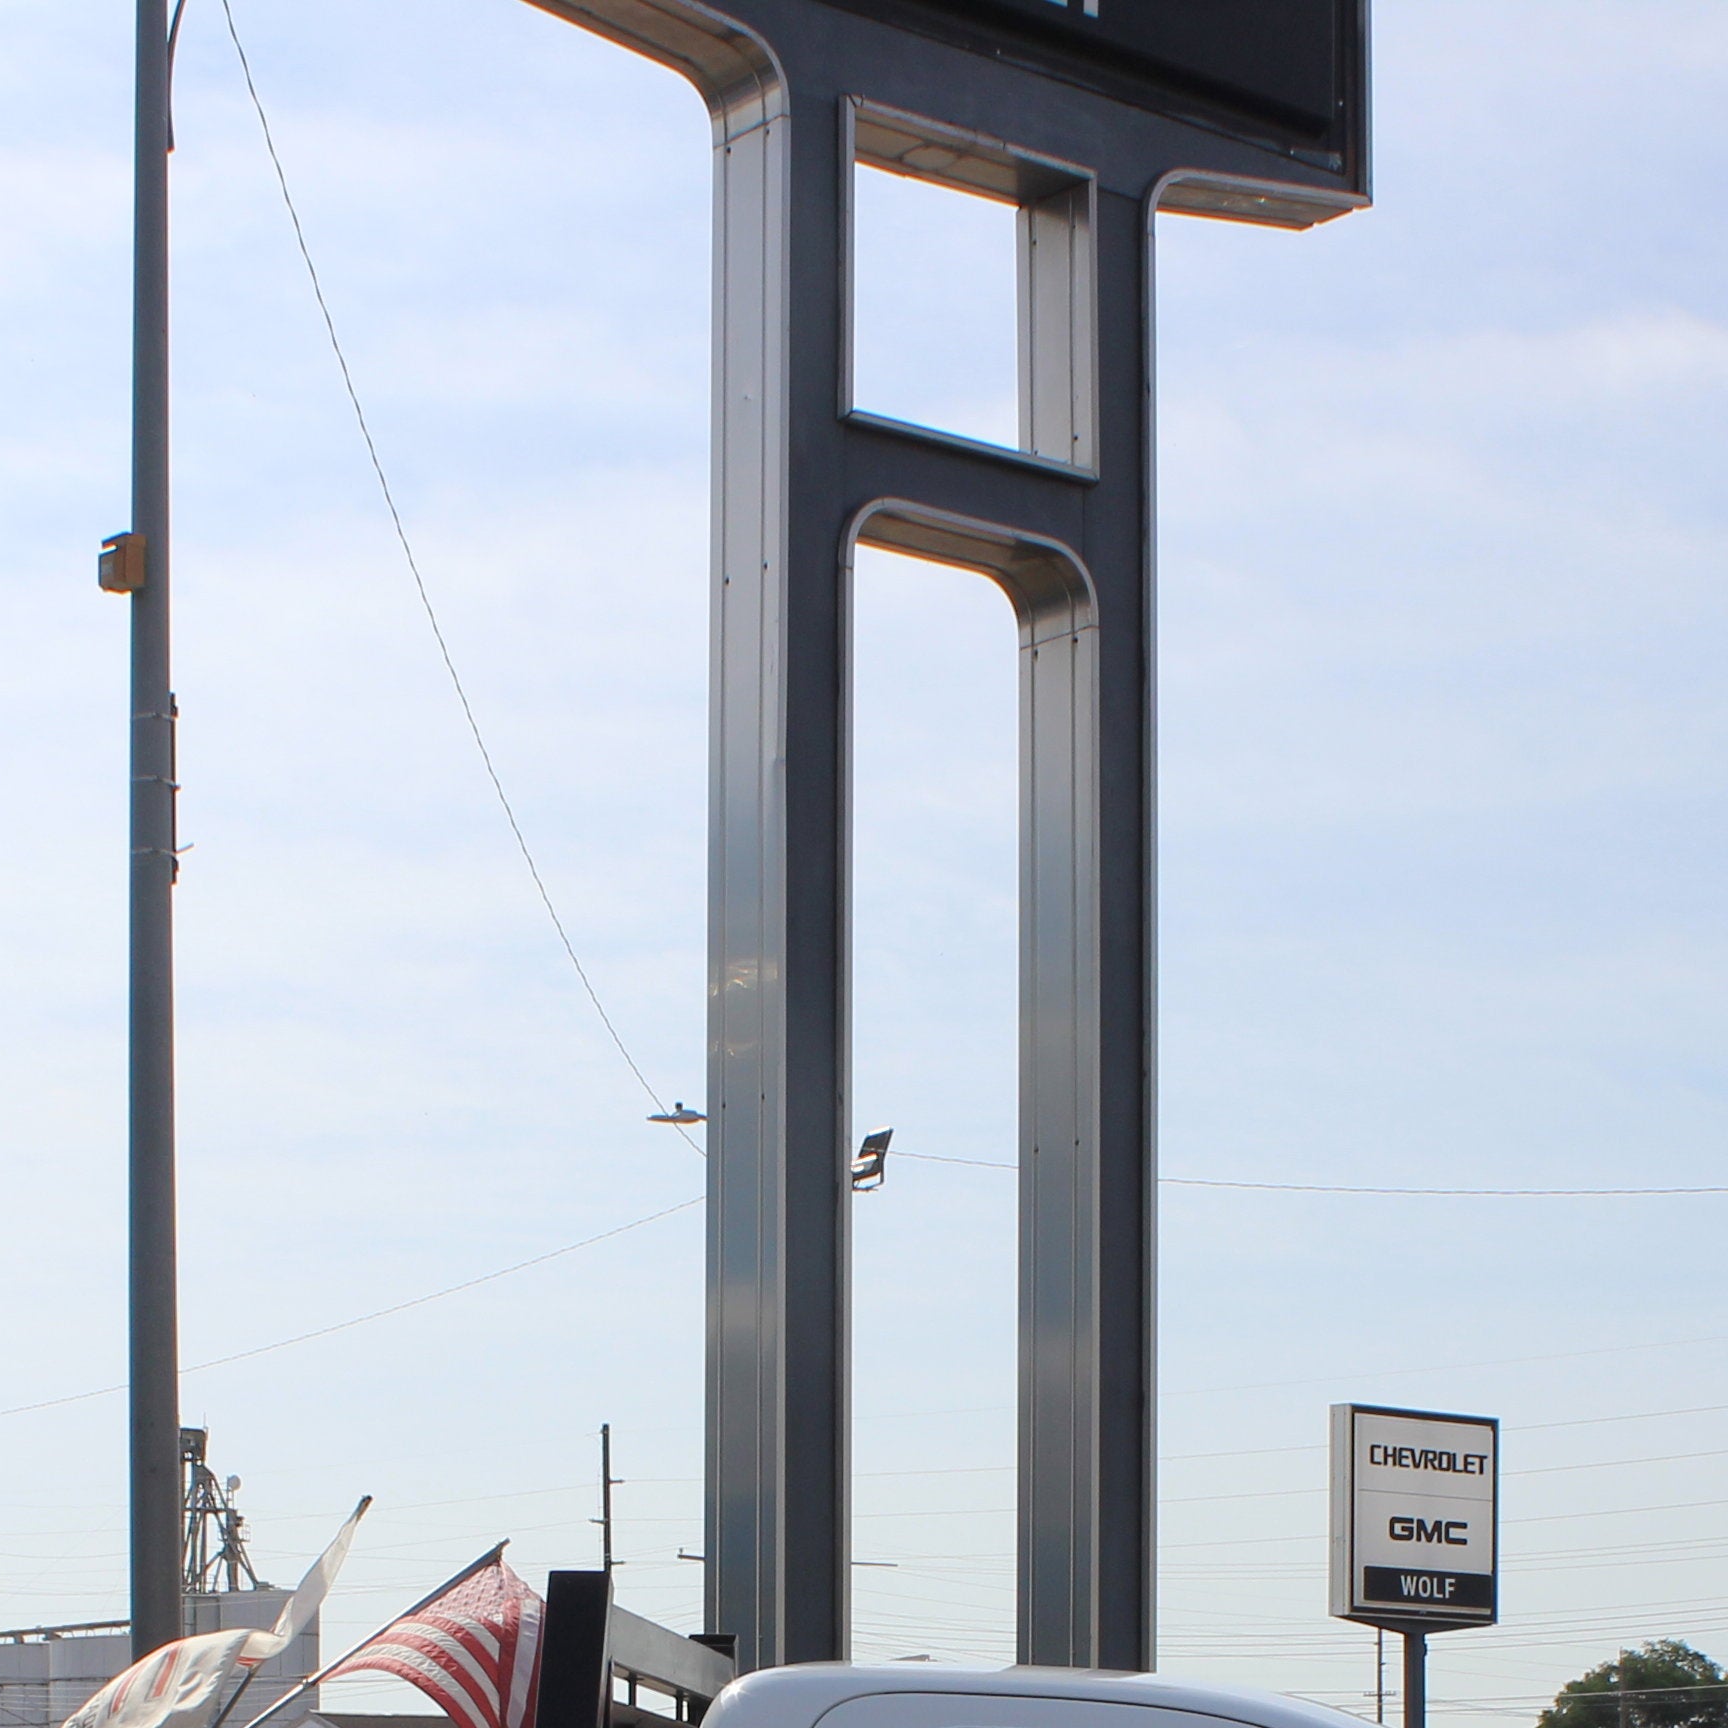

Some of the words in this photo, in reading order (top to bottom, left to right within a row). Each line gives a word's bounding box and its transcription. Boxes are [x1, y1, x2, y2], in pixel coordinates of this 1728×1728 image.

[1370, 1444, 1487, 1475] CHEVROLET
[1389, 1516, 1468, 1545] GMC
[1401, 1575, 1455, 1598] WOLF
